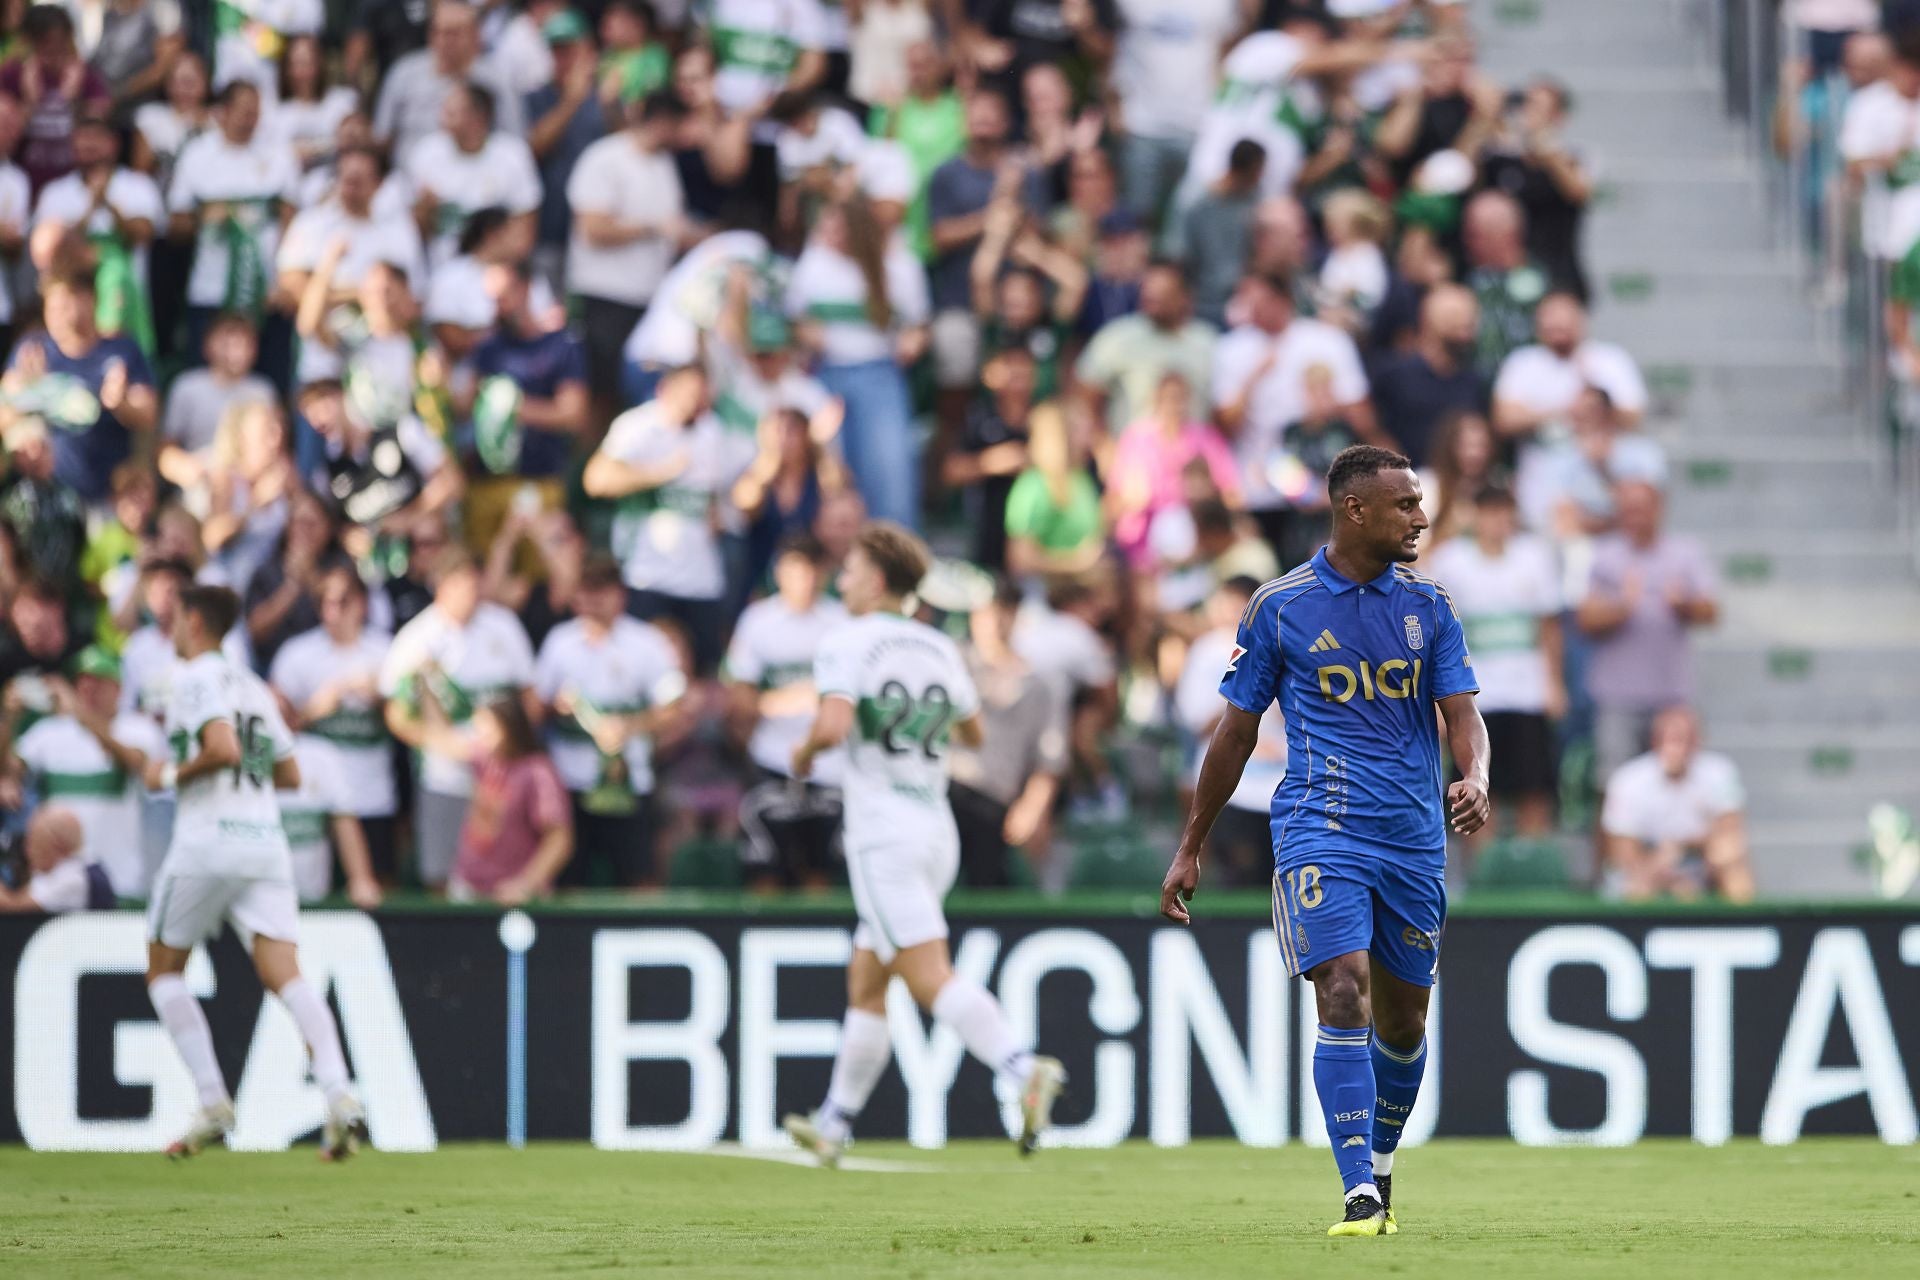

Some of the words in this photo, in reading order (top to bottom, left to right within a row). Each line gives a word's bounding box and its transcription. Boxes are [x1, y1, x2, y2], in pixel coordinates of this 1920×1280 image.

[1318, 659, 1422, 703] DIGI
[879, 680, 951, 759] 22
[1287, 866, 1322, 916] 10
[14, 910, 438, 1152] GA
[1507, 924, 1920, 1147] STA
[1334, 1109, 1369, 1123] 1926
